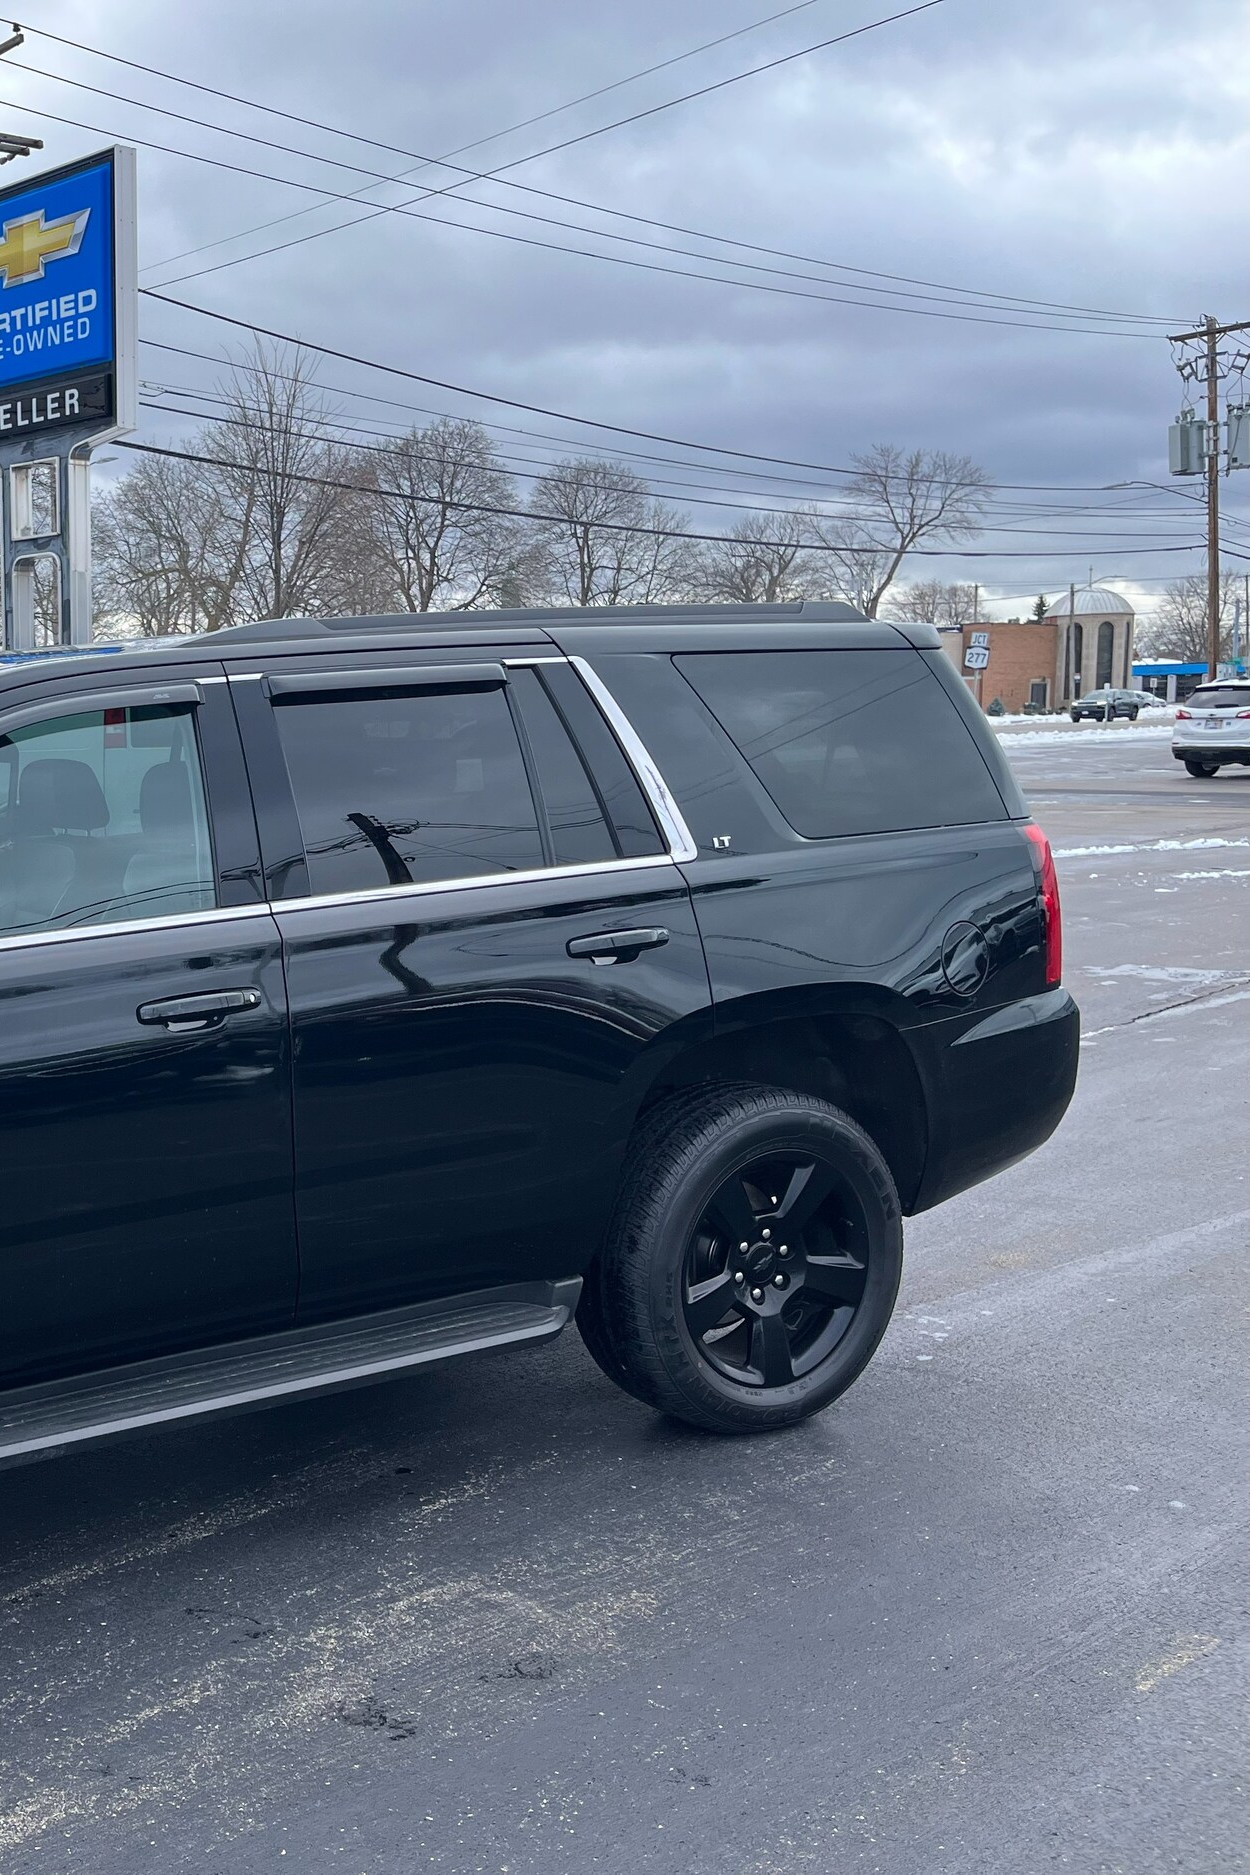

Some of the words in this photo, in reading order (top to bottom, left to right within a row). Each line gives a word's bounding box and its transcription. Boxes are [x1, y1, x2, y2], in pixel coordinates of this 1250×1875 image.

[972, 634, 987, 645] JCT
[967, 652, 987, 664] 277
[712, 835, 732, 849] LT
